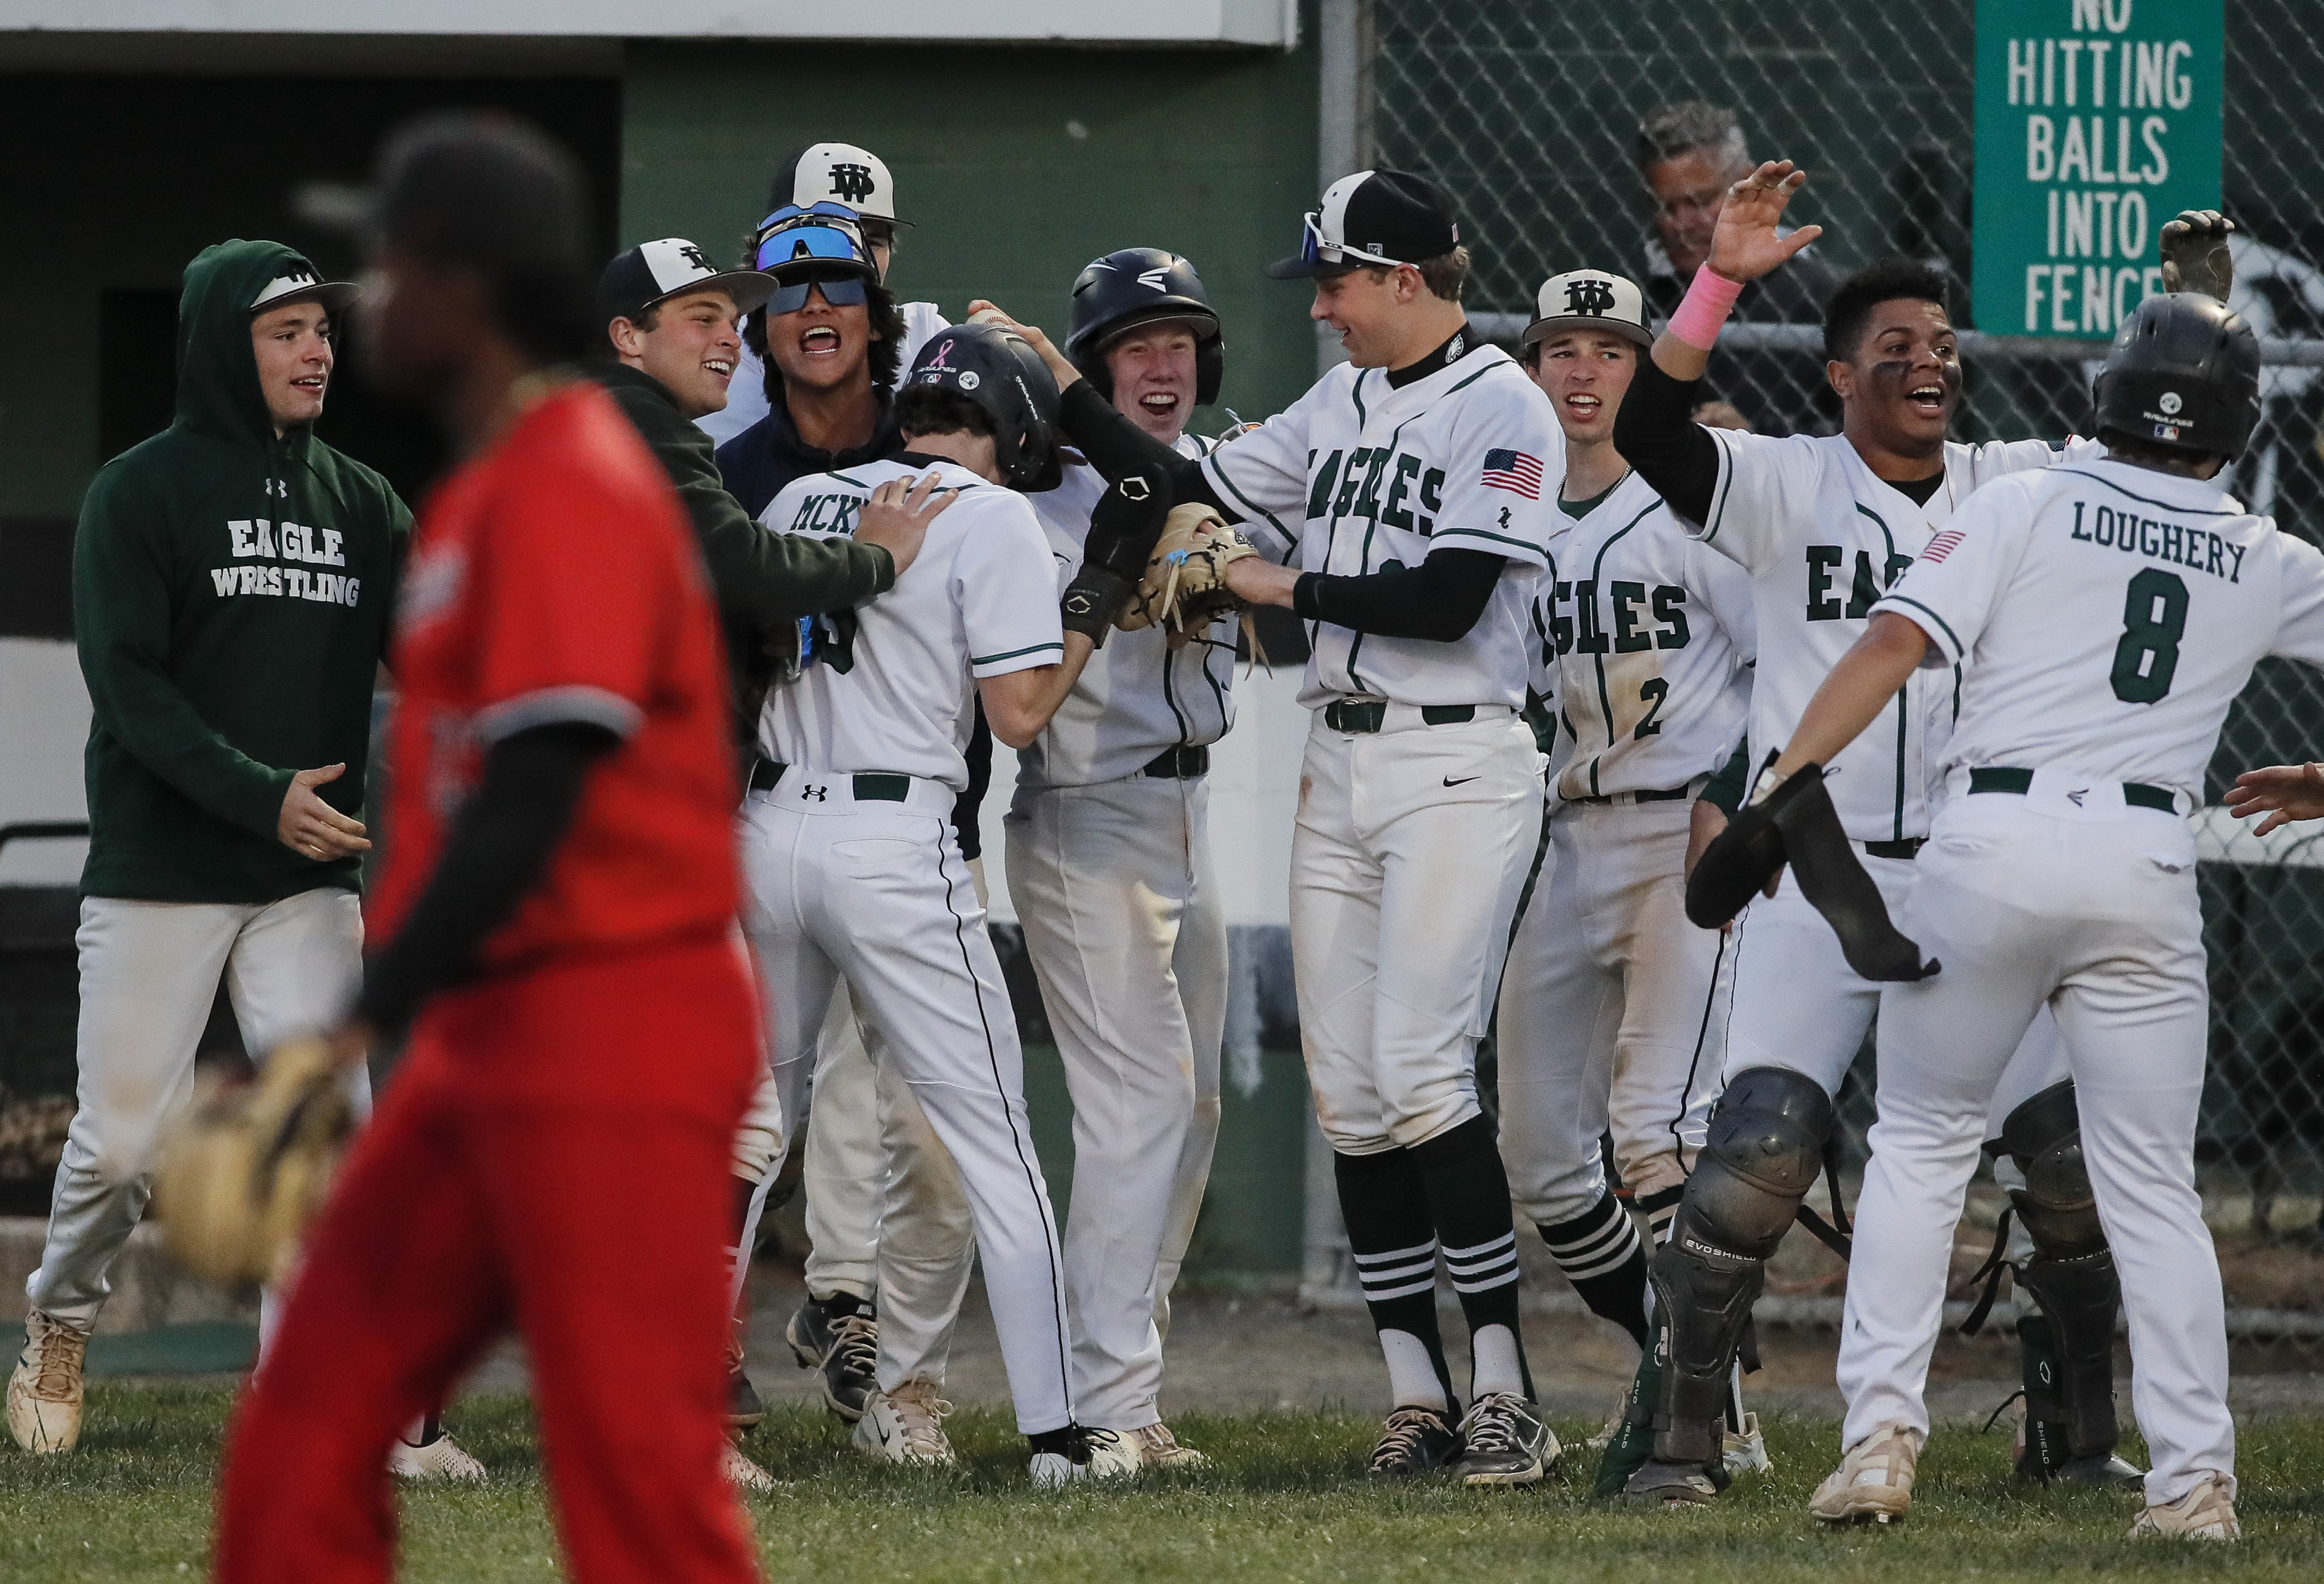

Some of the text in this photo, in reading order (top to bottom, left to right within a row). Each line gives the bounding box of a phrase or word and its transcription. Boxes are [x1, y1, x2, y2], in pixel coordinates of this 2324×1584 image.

[2008, 39, 2192, 110] HITTING
[2027, 115, 2169, 185] BALLS
[2048, 190, 2148, 260] INTO
[227, 518, 346, 567] EAGLE
[789, 494, 870, 536] MCK
[2070, 500, 2247, 584] LOUGHERY
[211, 564, 360, 608] WRESTLING
[2109, 566, 2190, 705] 8
[1634, 677, 1669, 741] 2
[2037, 1421, 2049, 1464] SHIELD
